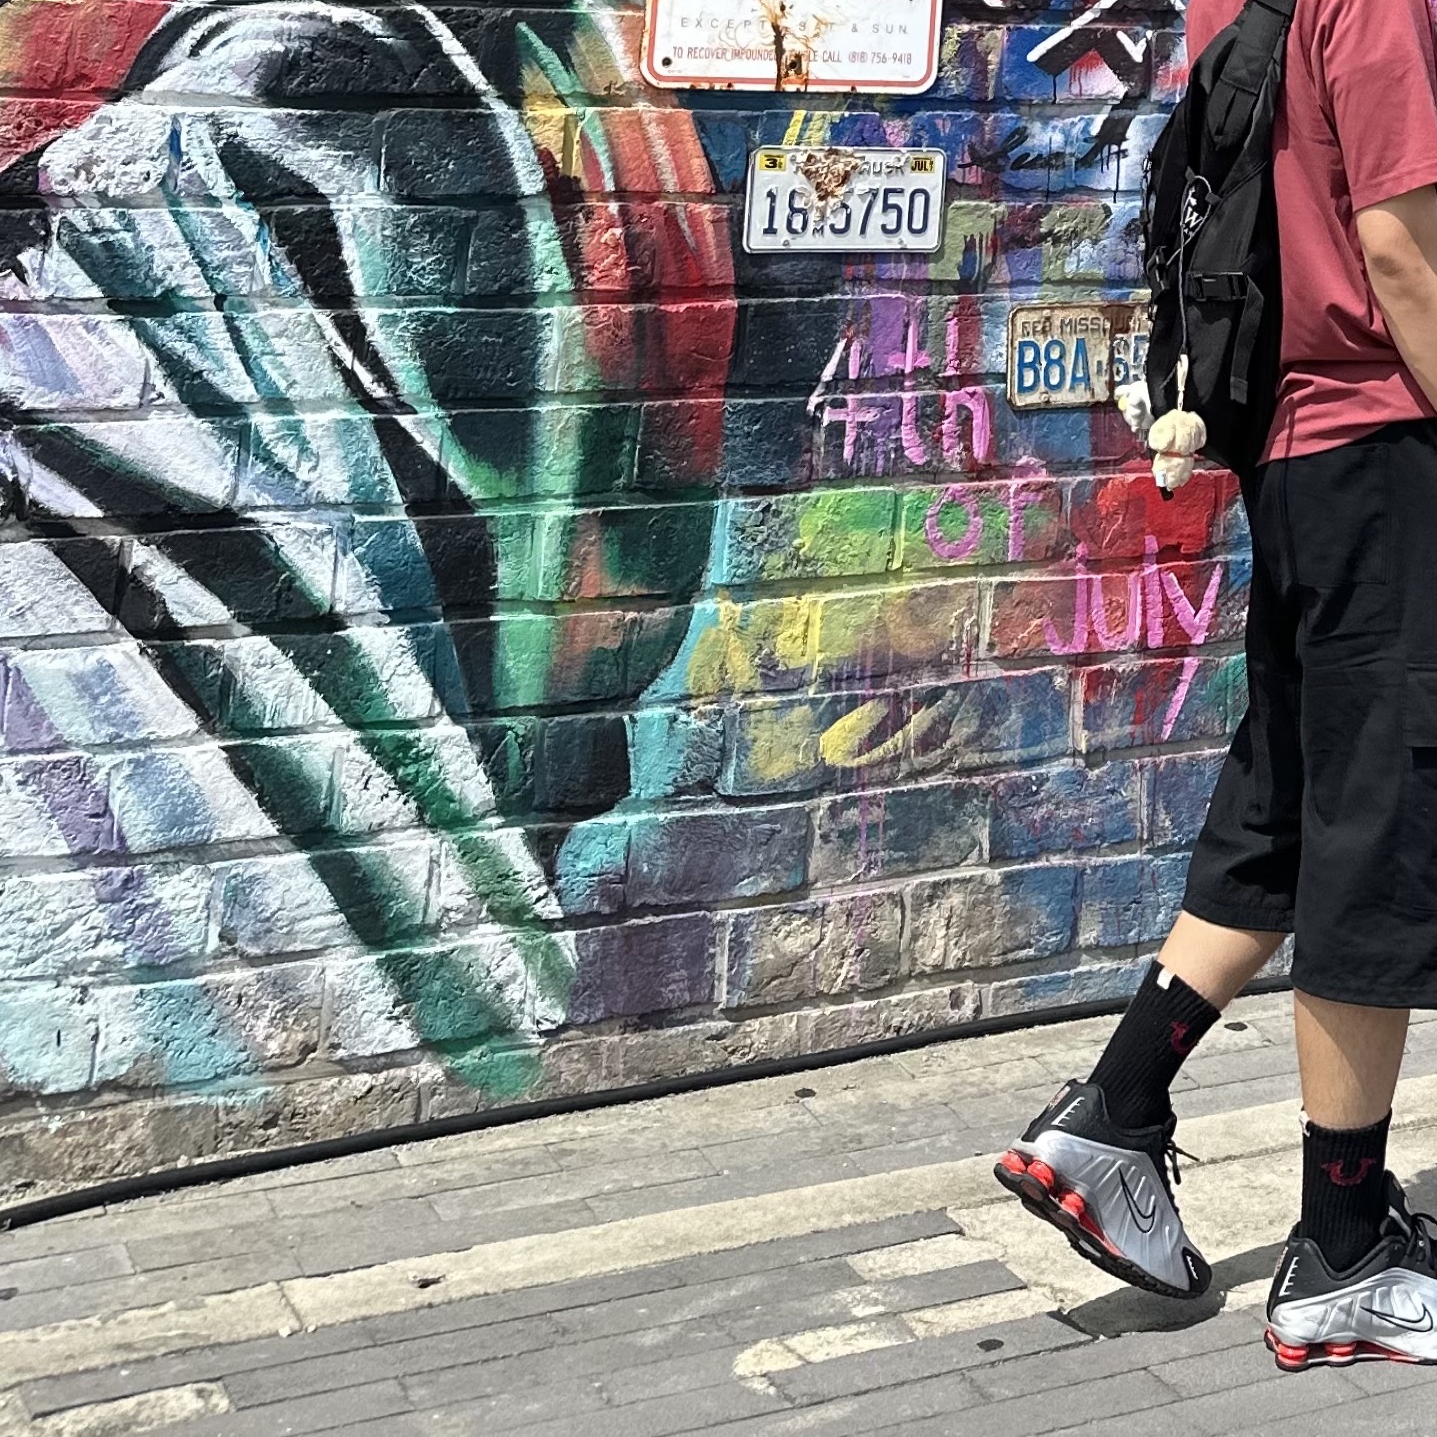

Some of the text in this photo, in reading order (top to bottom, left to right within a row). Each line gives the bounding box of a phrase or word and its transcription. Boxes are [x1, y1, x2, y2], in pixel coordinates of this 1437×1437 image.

[680, 17, 765, 31] EXCEPT
[871, 22, 909, 35] SUN
[672, 45, 684, 59] TO
[687, 46, 727, 60] RECOVER
[822, 50, 843, 63] CALL
